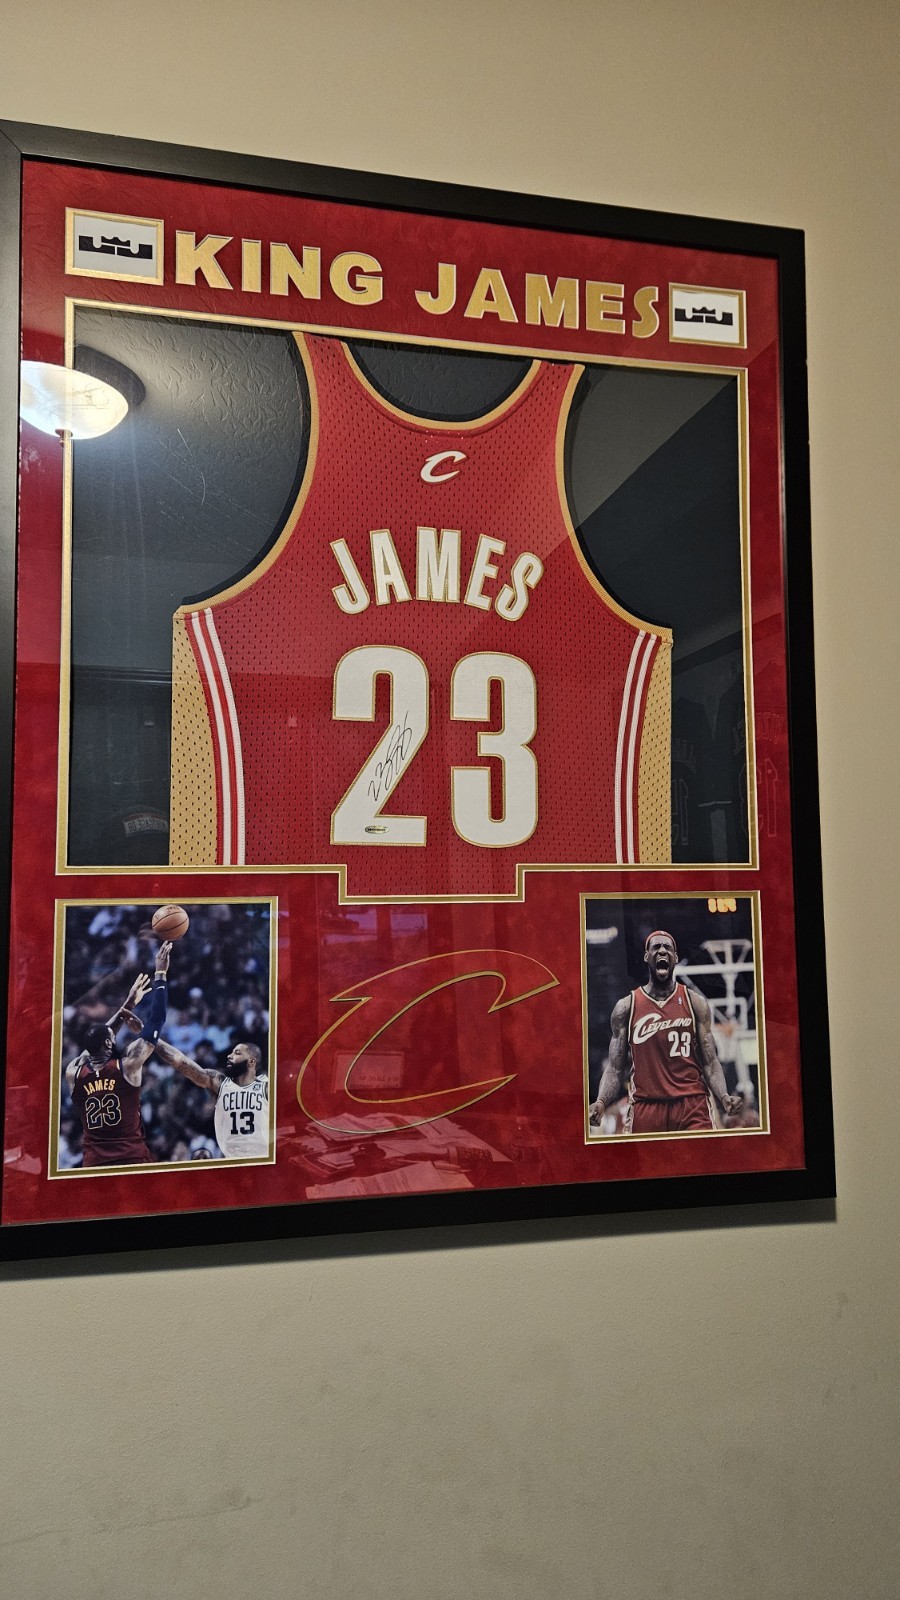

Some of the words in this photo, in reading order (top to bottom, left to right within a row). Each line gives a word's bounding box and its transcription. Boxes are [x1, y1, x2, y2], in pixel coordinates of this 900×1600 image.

[174, 231, 384, 306] KING
[414, 262, 661, 339] JAMES
[330, 526, 544, 622] JAMES
[330, 644, 539, 848] 23
[633, 1013, 692, 1044] CLEVELAND
[668, 1031, 691, 1058] 23
[83, 1078, 116, 1096] JAMES
[223, 1091, 263, 1112] CELTICS
[85, 1093, 122, 1130] 23
[230, 1111, 255, 1135] 13
